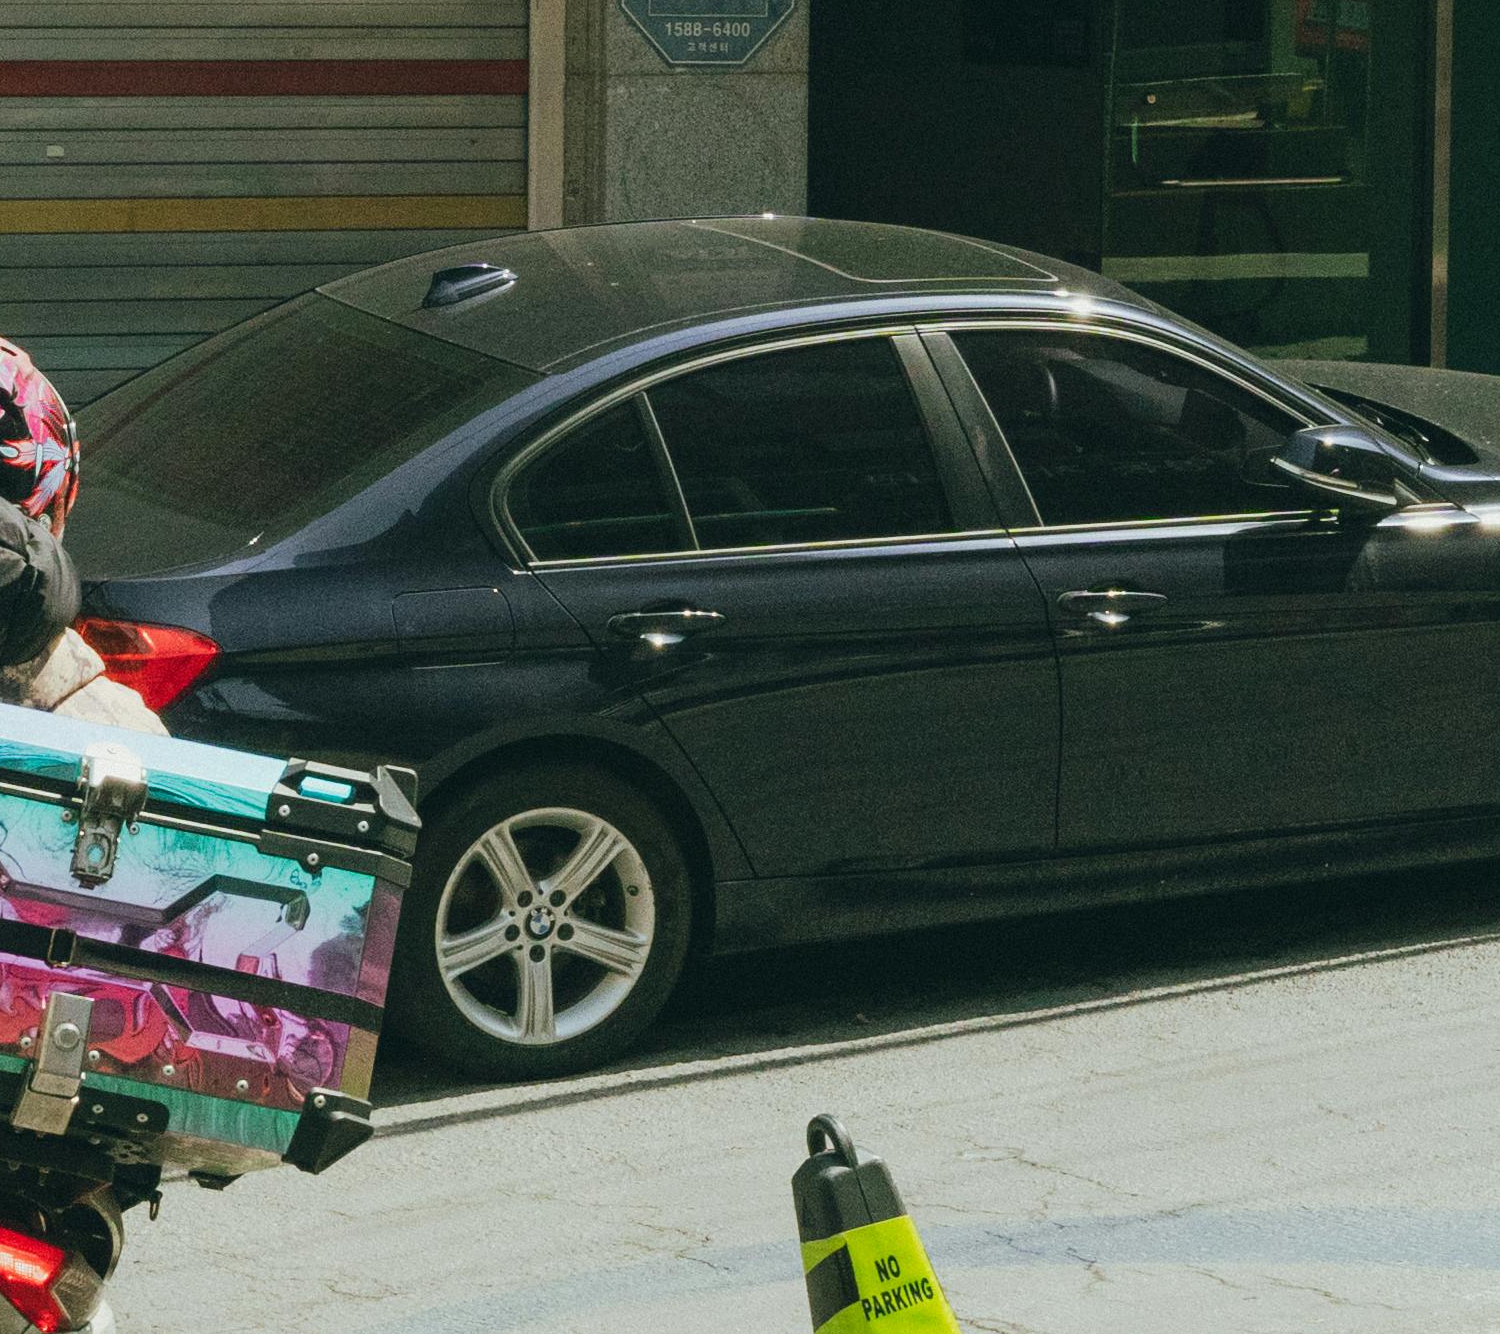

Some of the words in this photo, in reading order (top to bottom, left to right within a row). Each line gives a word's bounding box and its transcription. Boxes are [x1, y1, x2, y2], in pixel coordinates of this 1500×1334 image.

[665, 22, 750, 37] 1588-6400
[875, 1255, 900, 1282] NO
[861, 1278, 934, 1320] PARKING
